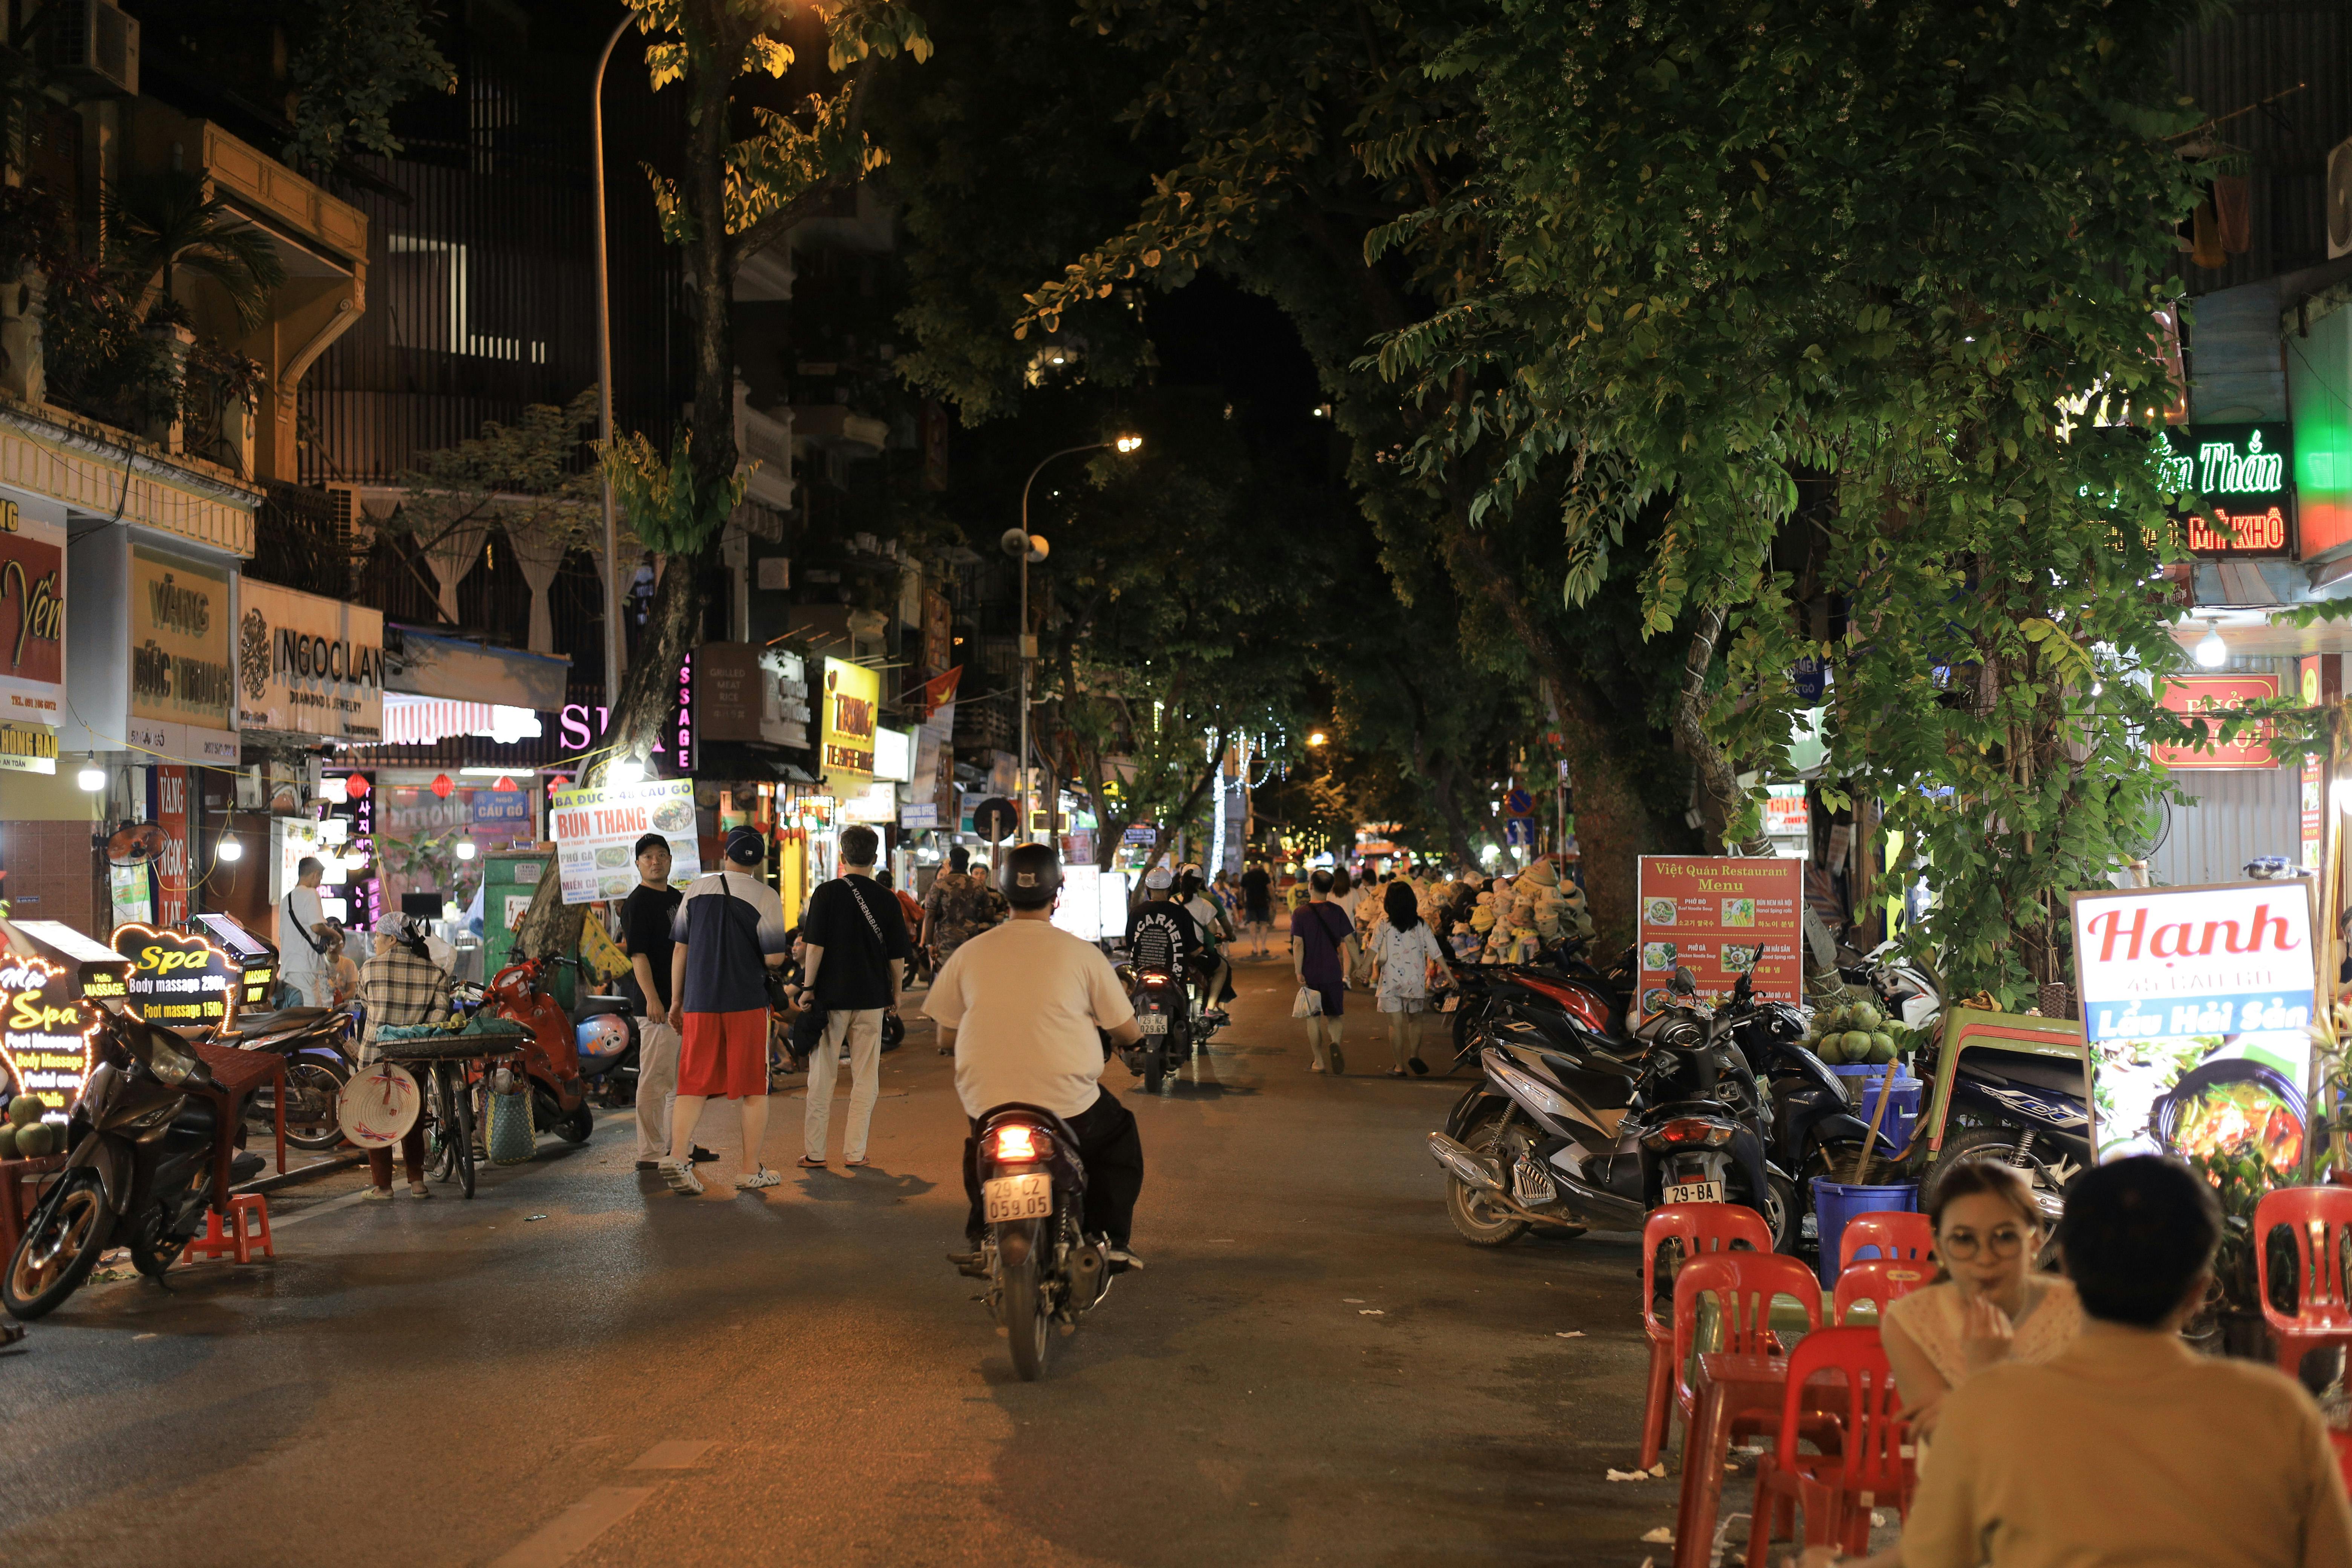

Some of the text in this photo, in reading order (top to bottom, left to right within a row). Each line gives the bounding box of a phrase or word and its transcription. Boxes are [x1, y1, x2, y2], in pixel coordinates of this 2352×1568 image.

[2231, 507, 2283, 550] KHÔ
[149, 573, 210, 632] VÀNG
[4, 560, 63, 667] Yến
[678, 652, 691, 768] SSAGE
[0, 723, 34, 756] HÔNG
[160, 767, 184, 814] VÀNG
[557, 806, 648, 839] BÚN THANG
[161, 838, 184, 885] NGỌC
[1655, 862, 1788, 878] Việt Quán Restaurant
[1698, 878, 1744, 891] Menu
[1784, 898, 1793, 908] NỘI
[2087, 903, 2301, 968] Hạnh
[1687, 943, 1697, 952] PHỞ
[1762, 943, 1791, 952] EM HẢI SẢN
[137, 946, 210, 975] Spa
[93, 973, 112, 983] Hello
[129, 977, 153, 994] Body
[156, 977, 200, 994] massage
[243, 968, 272, 985] MASSAGE
[84, 983, 126, 997] MASSAGE
[247, 986, 263, 1003] BODY
[9, 990, 79, 1031] Spa
[144, 1001, 224, 1019] Foot massage 150k
[2097, 997, 2308, 1037] Lẩu Hải Sản
[1140, 1024, 1166, 1033] 029.65
[5, 1032, 83, 1052] Foot Massage
[16, 1053, 83, 1071] Body Massage
[57, 1073, 81, 1087] care
[1672, 1184, 1713, 1203] 29-BA
[990, 1196, 1047, 1219] 059.05
